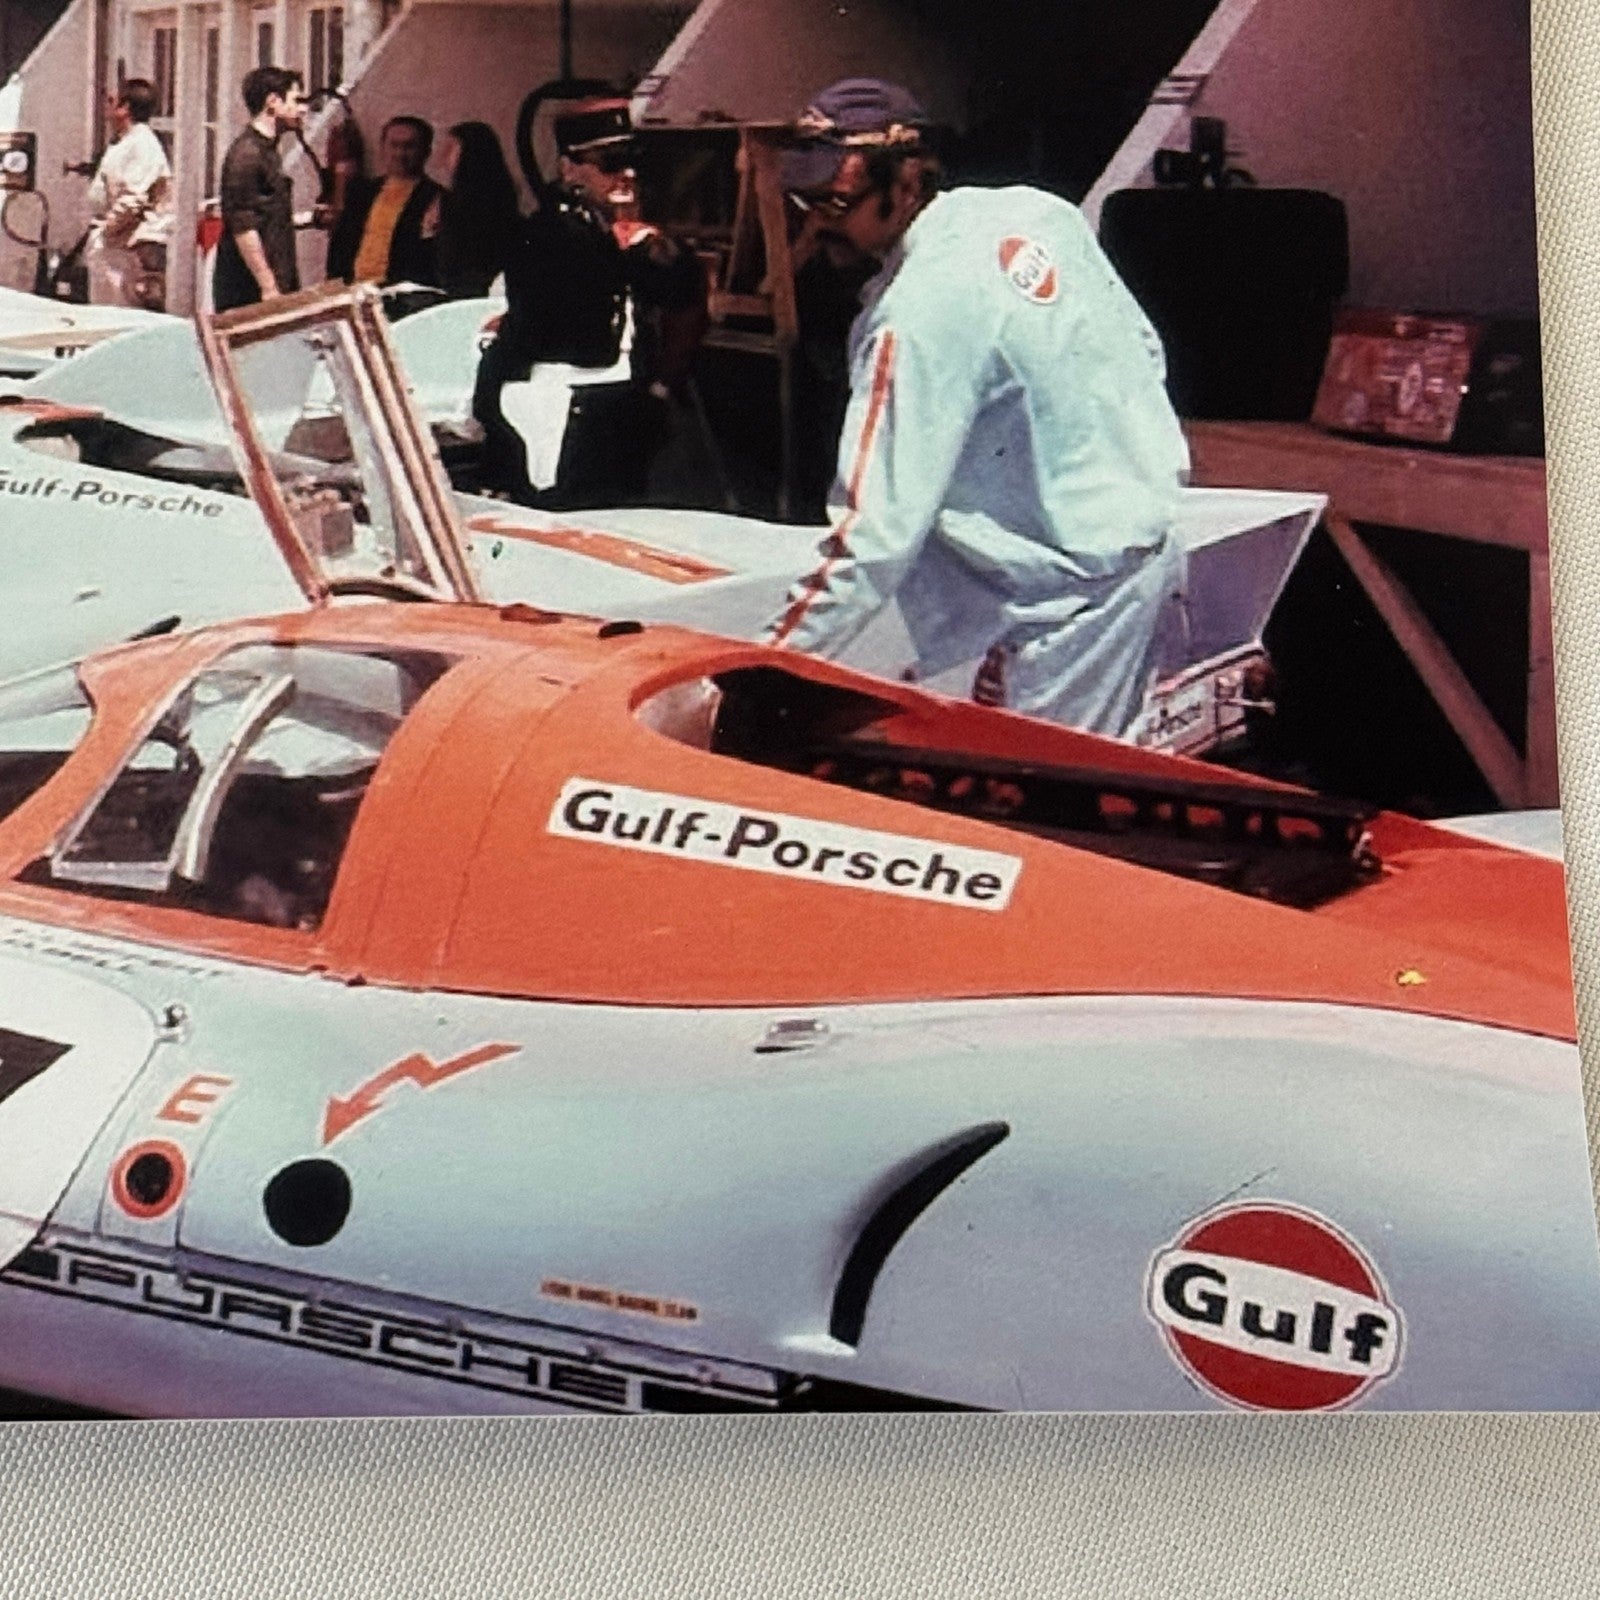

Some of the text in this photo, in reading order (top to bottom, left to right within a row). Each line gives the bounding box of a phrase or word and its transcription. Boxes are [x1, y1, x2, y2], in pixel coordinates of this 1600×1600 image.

[563, 789, 1003, 901] Gulf-Porsche
[155, 1073, 235, 1124] E
[68, 1258, 628, 1407] PORSCHE
[1162, 1262, 1389, 1364] Gulf
